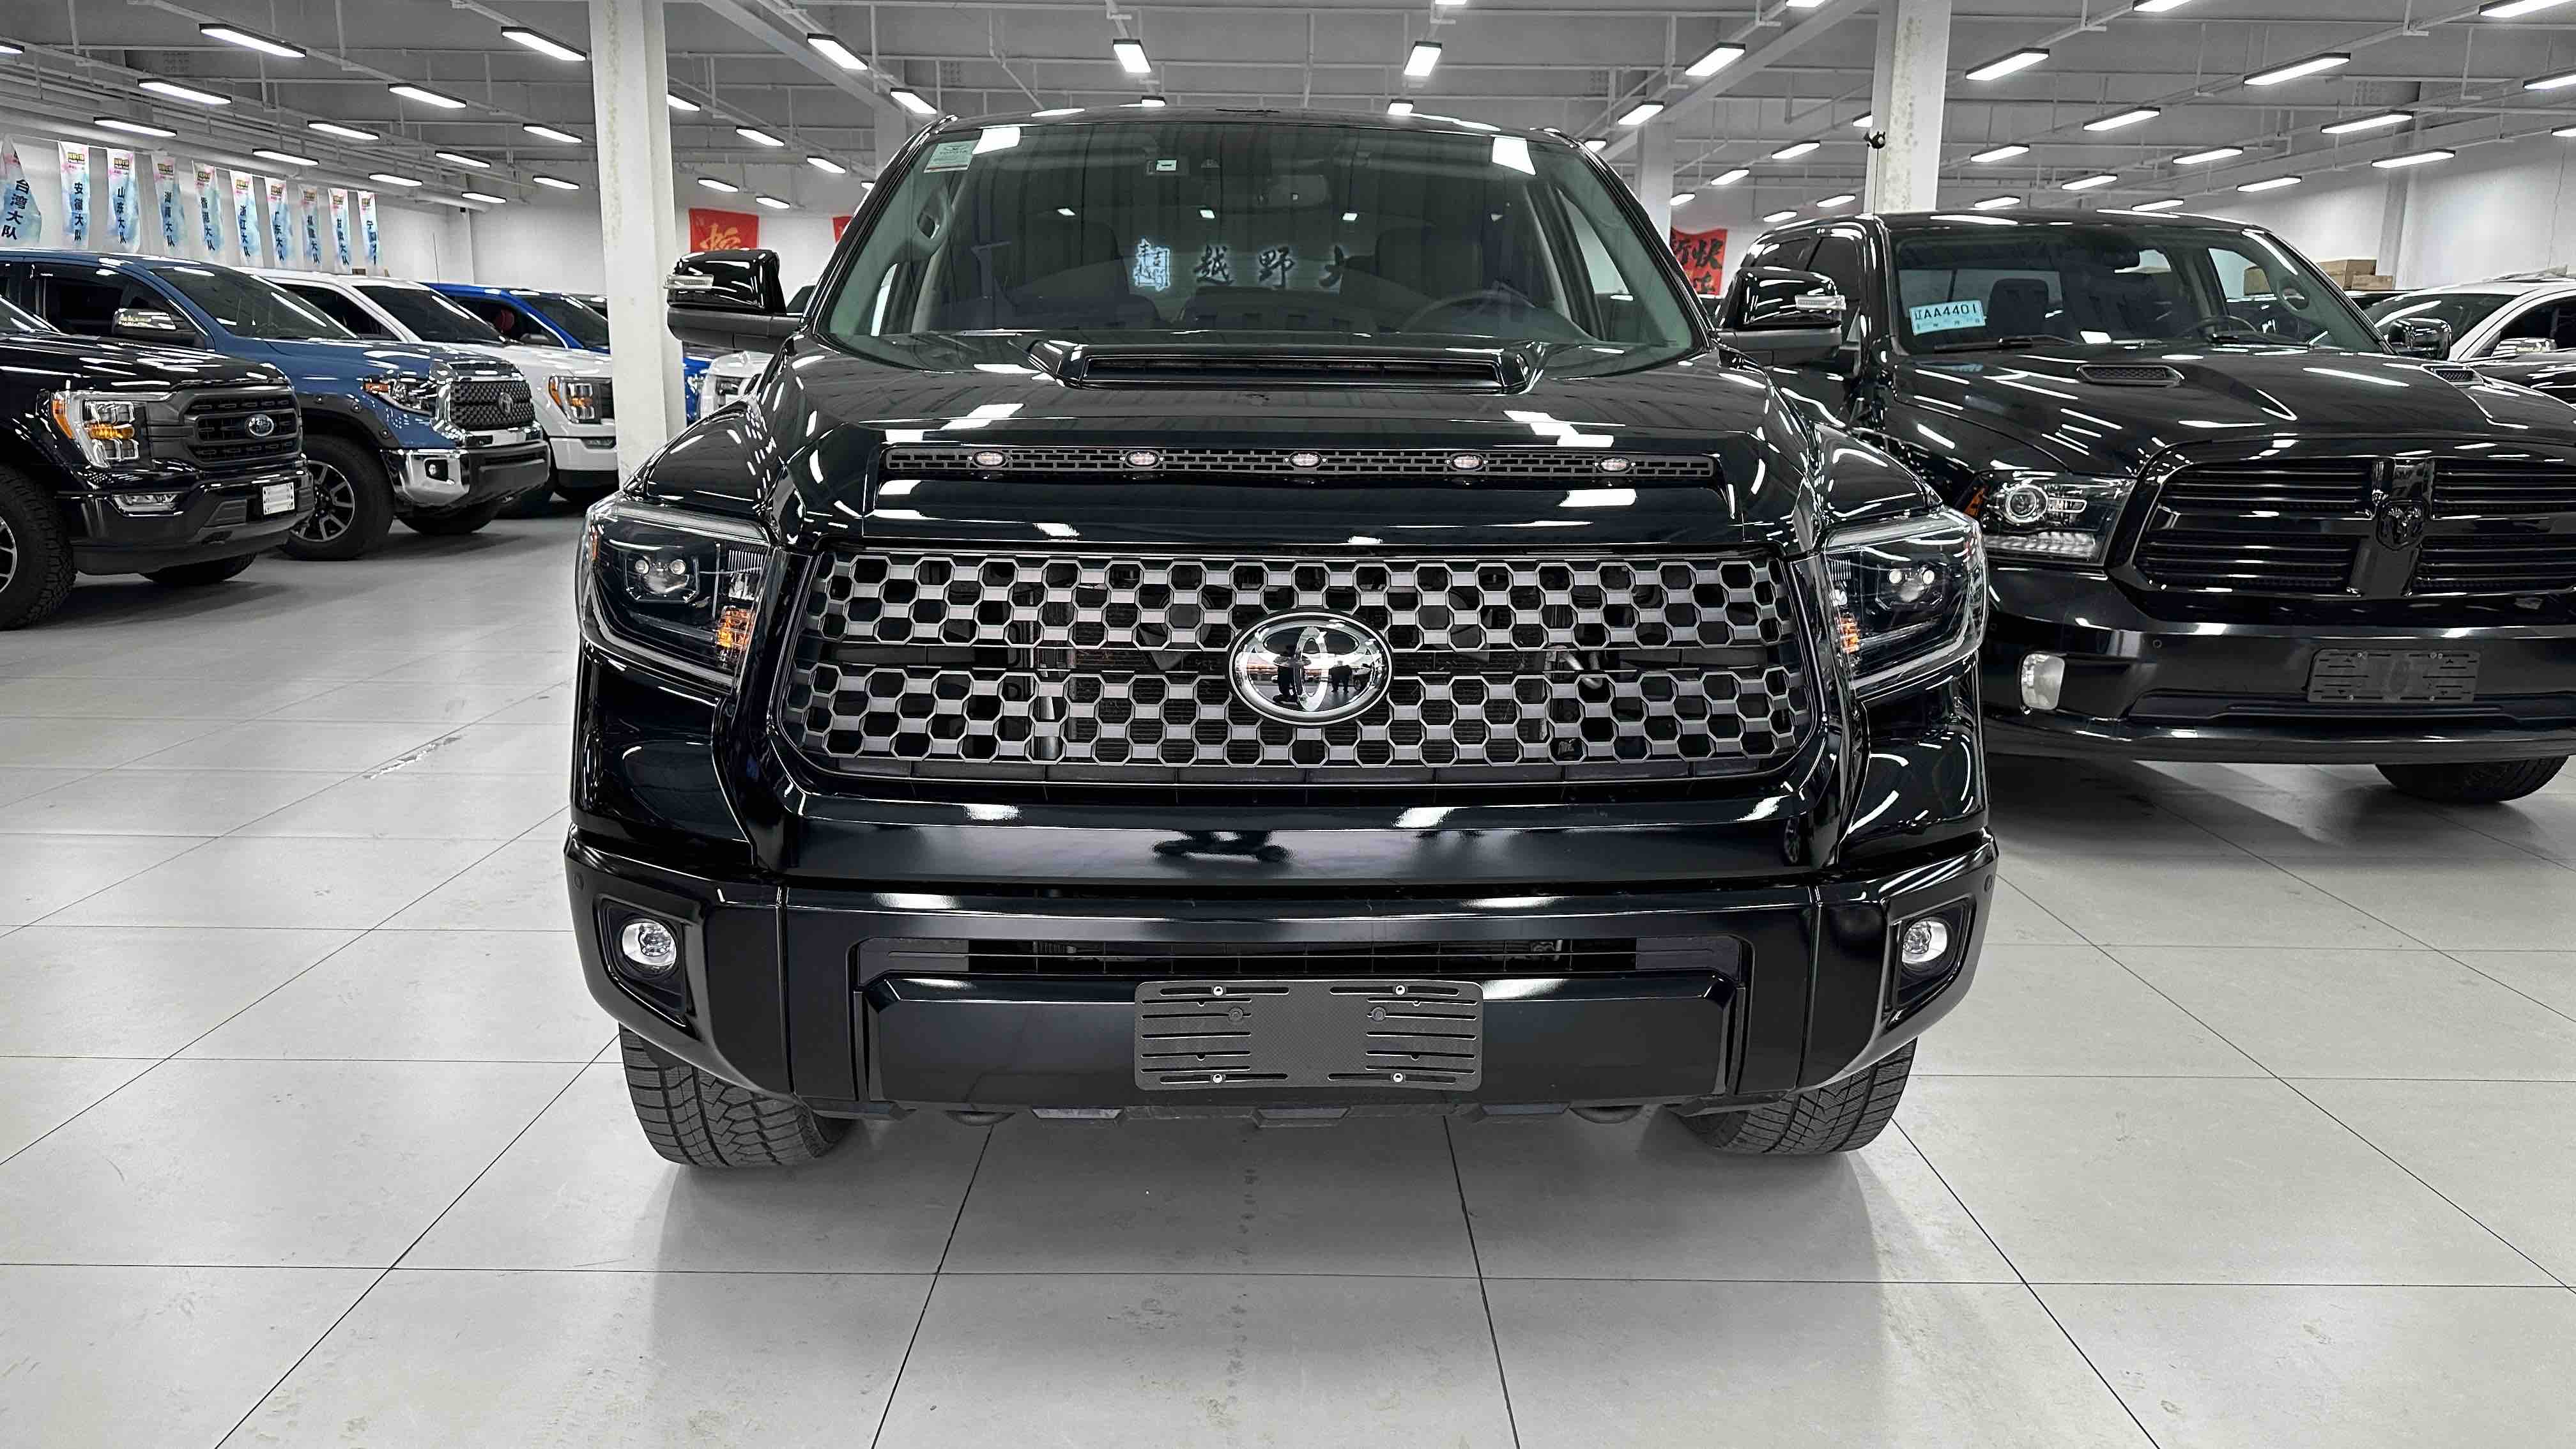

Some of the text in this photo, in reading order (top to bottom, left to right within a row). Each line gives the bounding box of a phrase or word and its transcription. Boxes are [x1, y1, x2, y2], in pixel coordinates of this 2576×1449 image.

[1, 178, 30, 240] 台湾大队
[73, 181, 84, 241] 安徽大队
